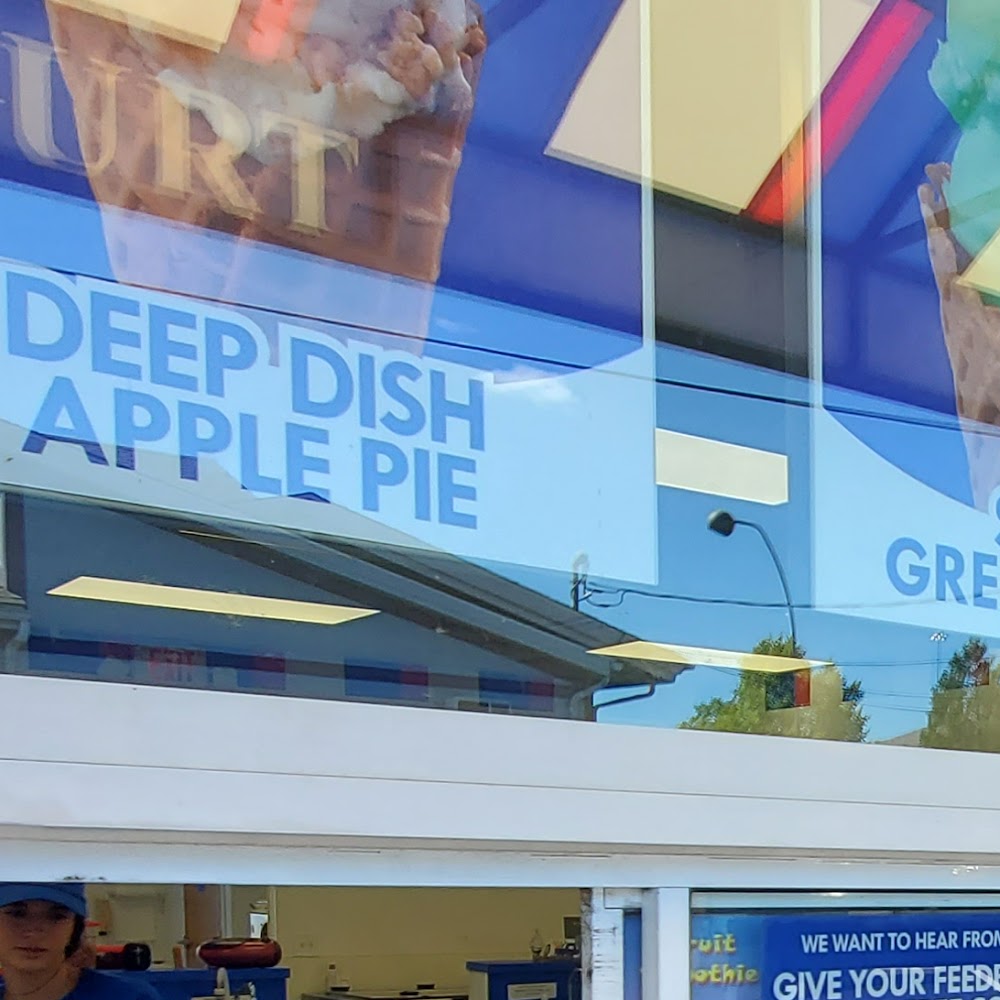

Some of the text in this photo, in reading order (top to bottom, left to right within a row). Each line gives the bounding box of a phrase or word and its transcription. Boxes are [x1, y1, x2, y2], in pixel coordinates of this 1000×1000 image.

[6, 271, 485, 451] DEEP DISH
[22, 375, 478, 530] APPLE PIE
[801, 935, 828, 953] WE
[832, 932, 885, 953] WANT
[888, 932, 911, 950] TO
[915, 930, 958, 950] HEAR
[849, 967, 926, 998] YOUR
